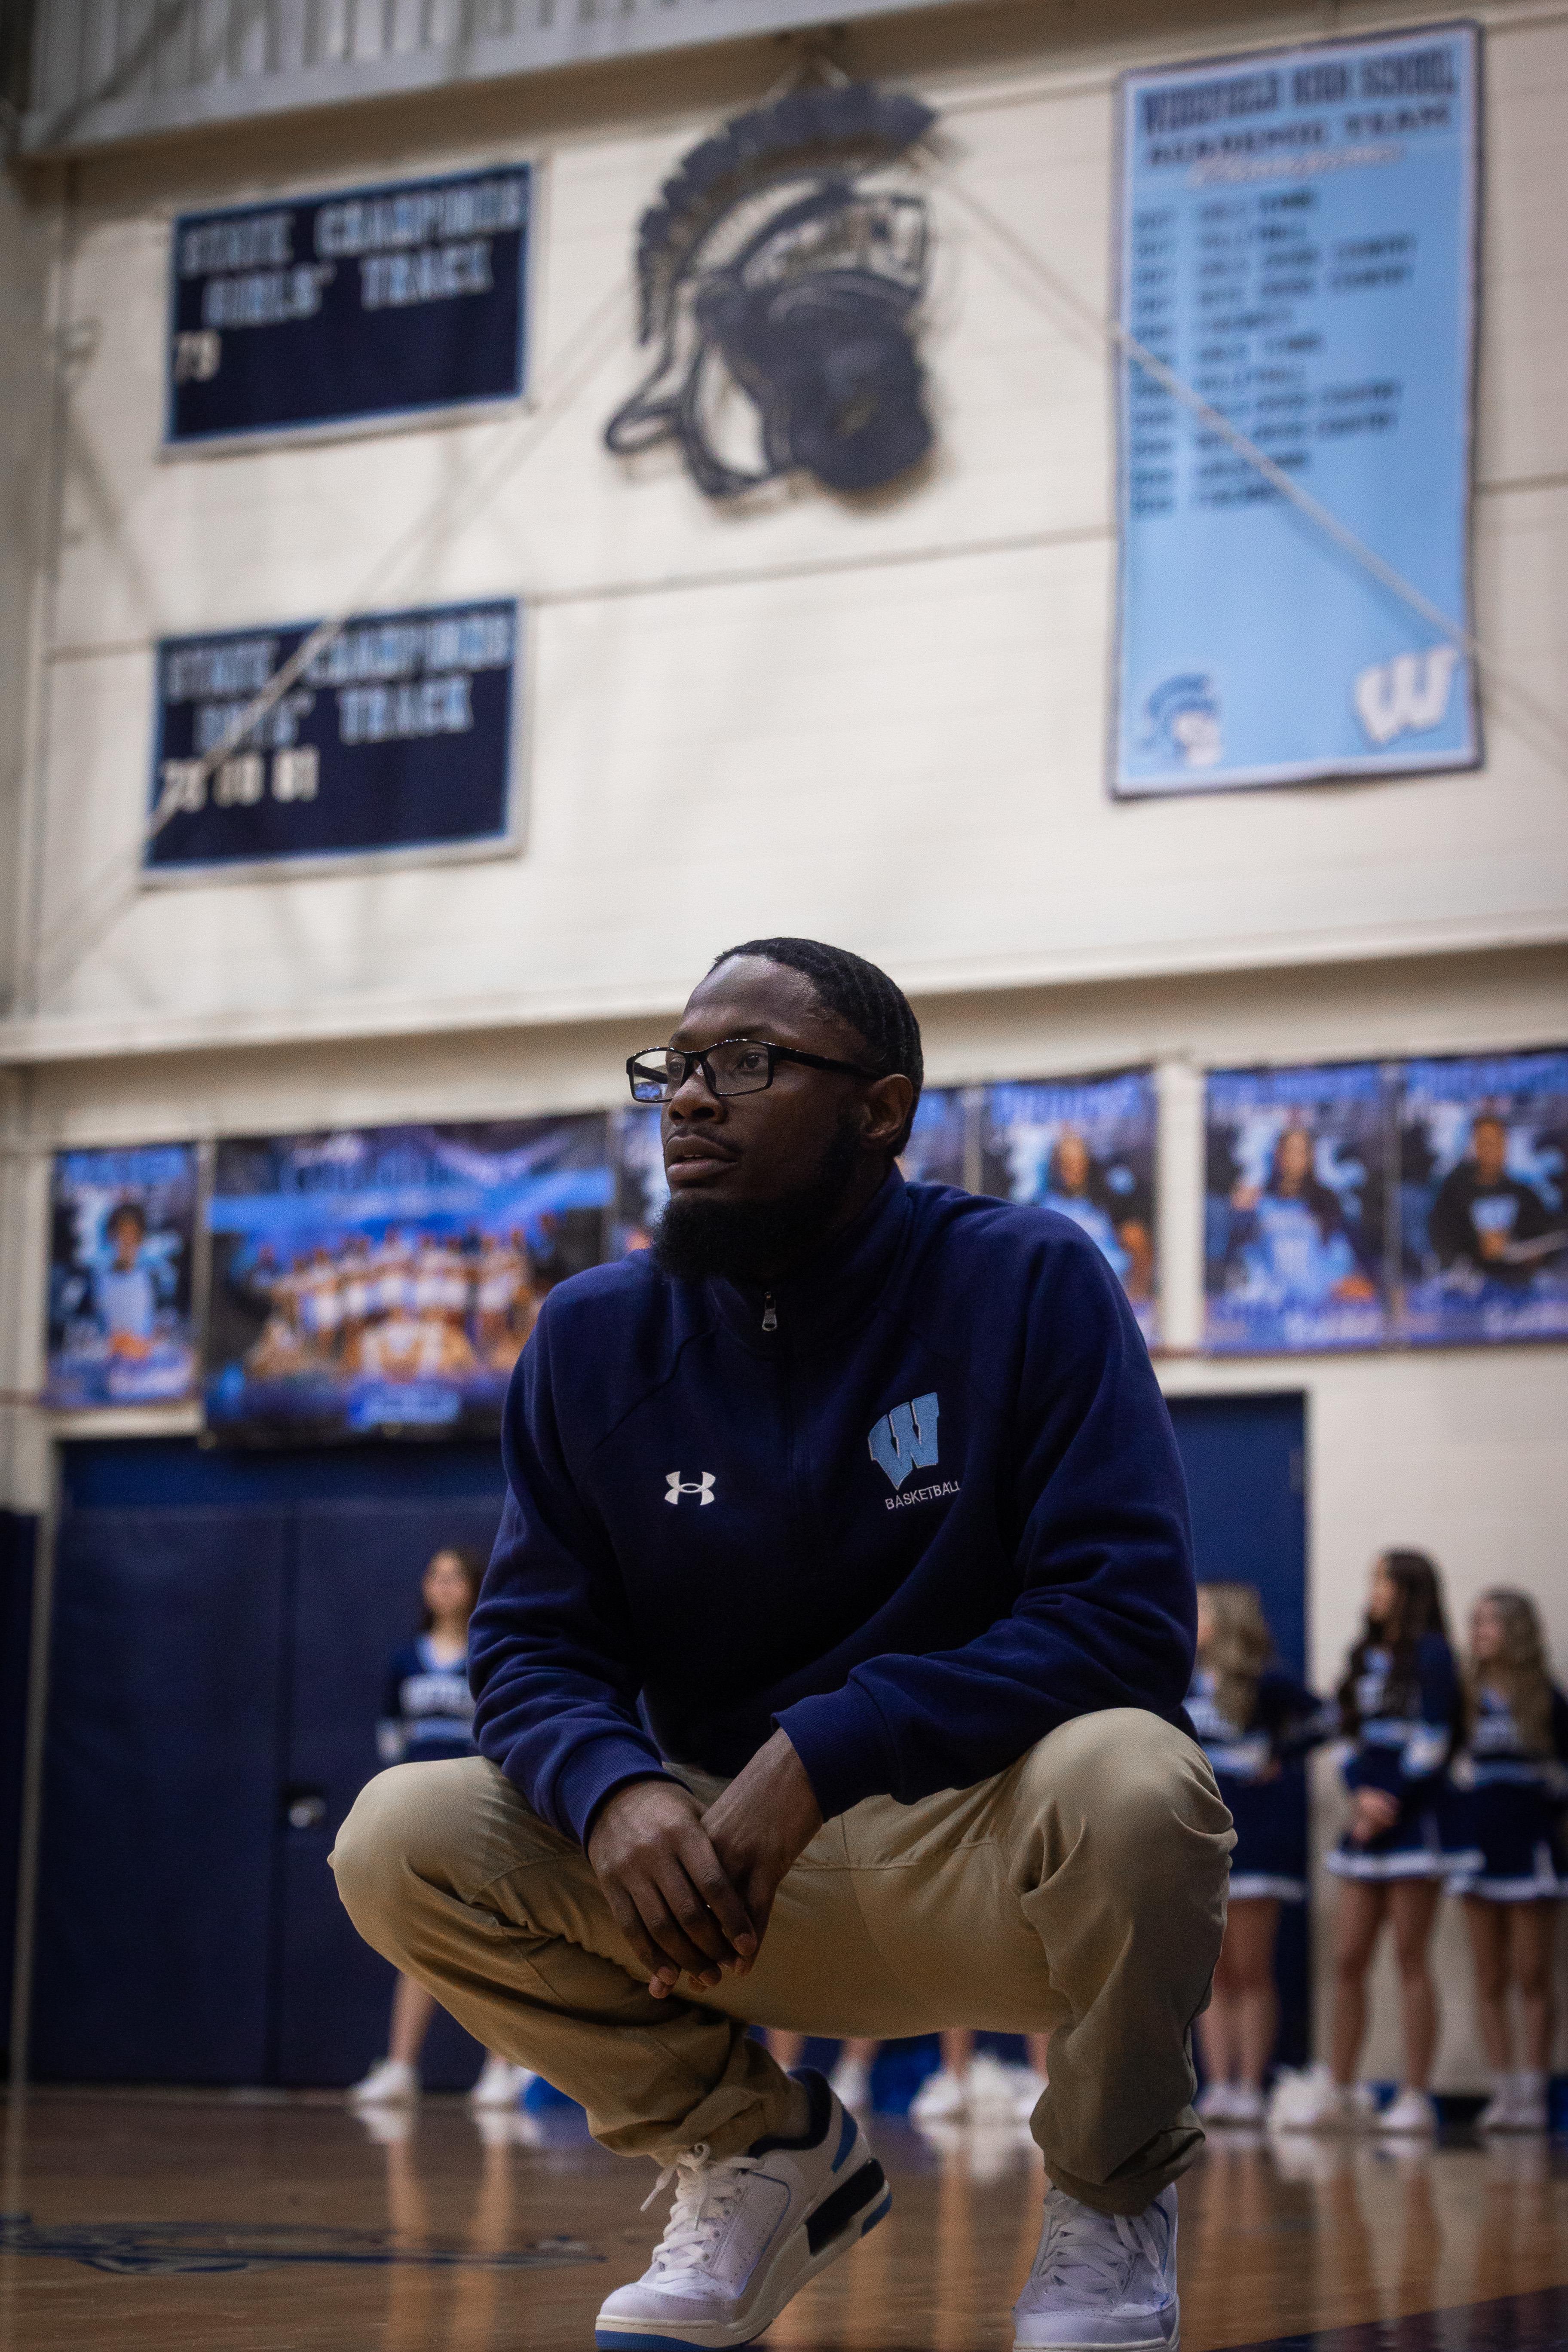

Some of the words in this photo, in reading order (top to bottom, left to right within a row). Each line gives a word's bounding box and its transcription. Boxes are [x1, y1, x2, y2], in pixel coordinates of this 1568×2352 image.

[1356, 643, 1458, 744] W
[868, 1392, 939, 1490] W
[885, 1481, 961, 1510] BASKETBALL
